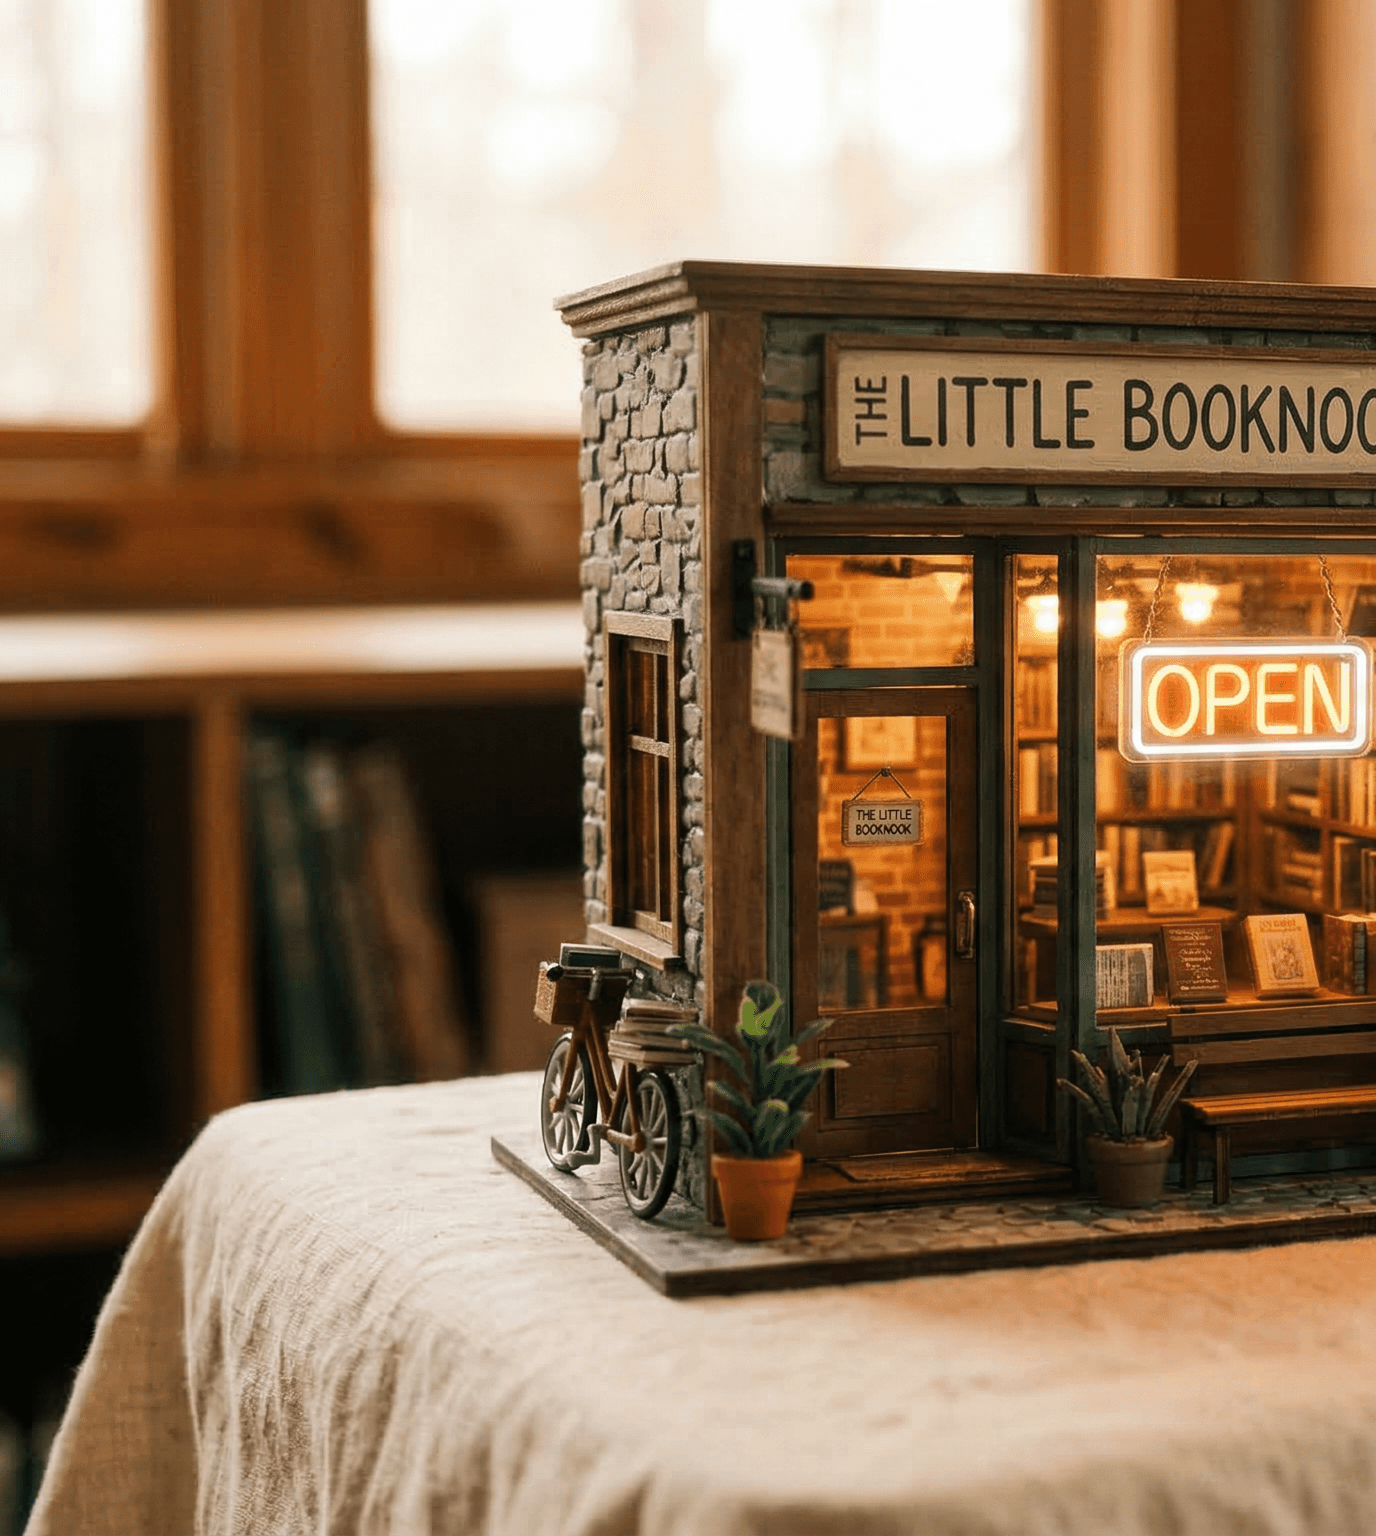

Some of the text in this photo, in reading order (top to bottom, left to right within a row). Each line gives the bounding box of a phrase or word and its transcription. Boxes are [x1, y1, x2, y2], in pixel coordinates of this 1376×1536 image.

[854, 375, 888, 446] THE
[900, 374, 1096, 450] LITTLE
[1147, 662, 1351, 738] OPEN
[855, 808, 912, 821] THE LITTLE
[855, 823, 912, 836] BOOKNOOK
